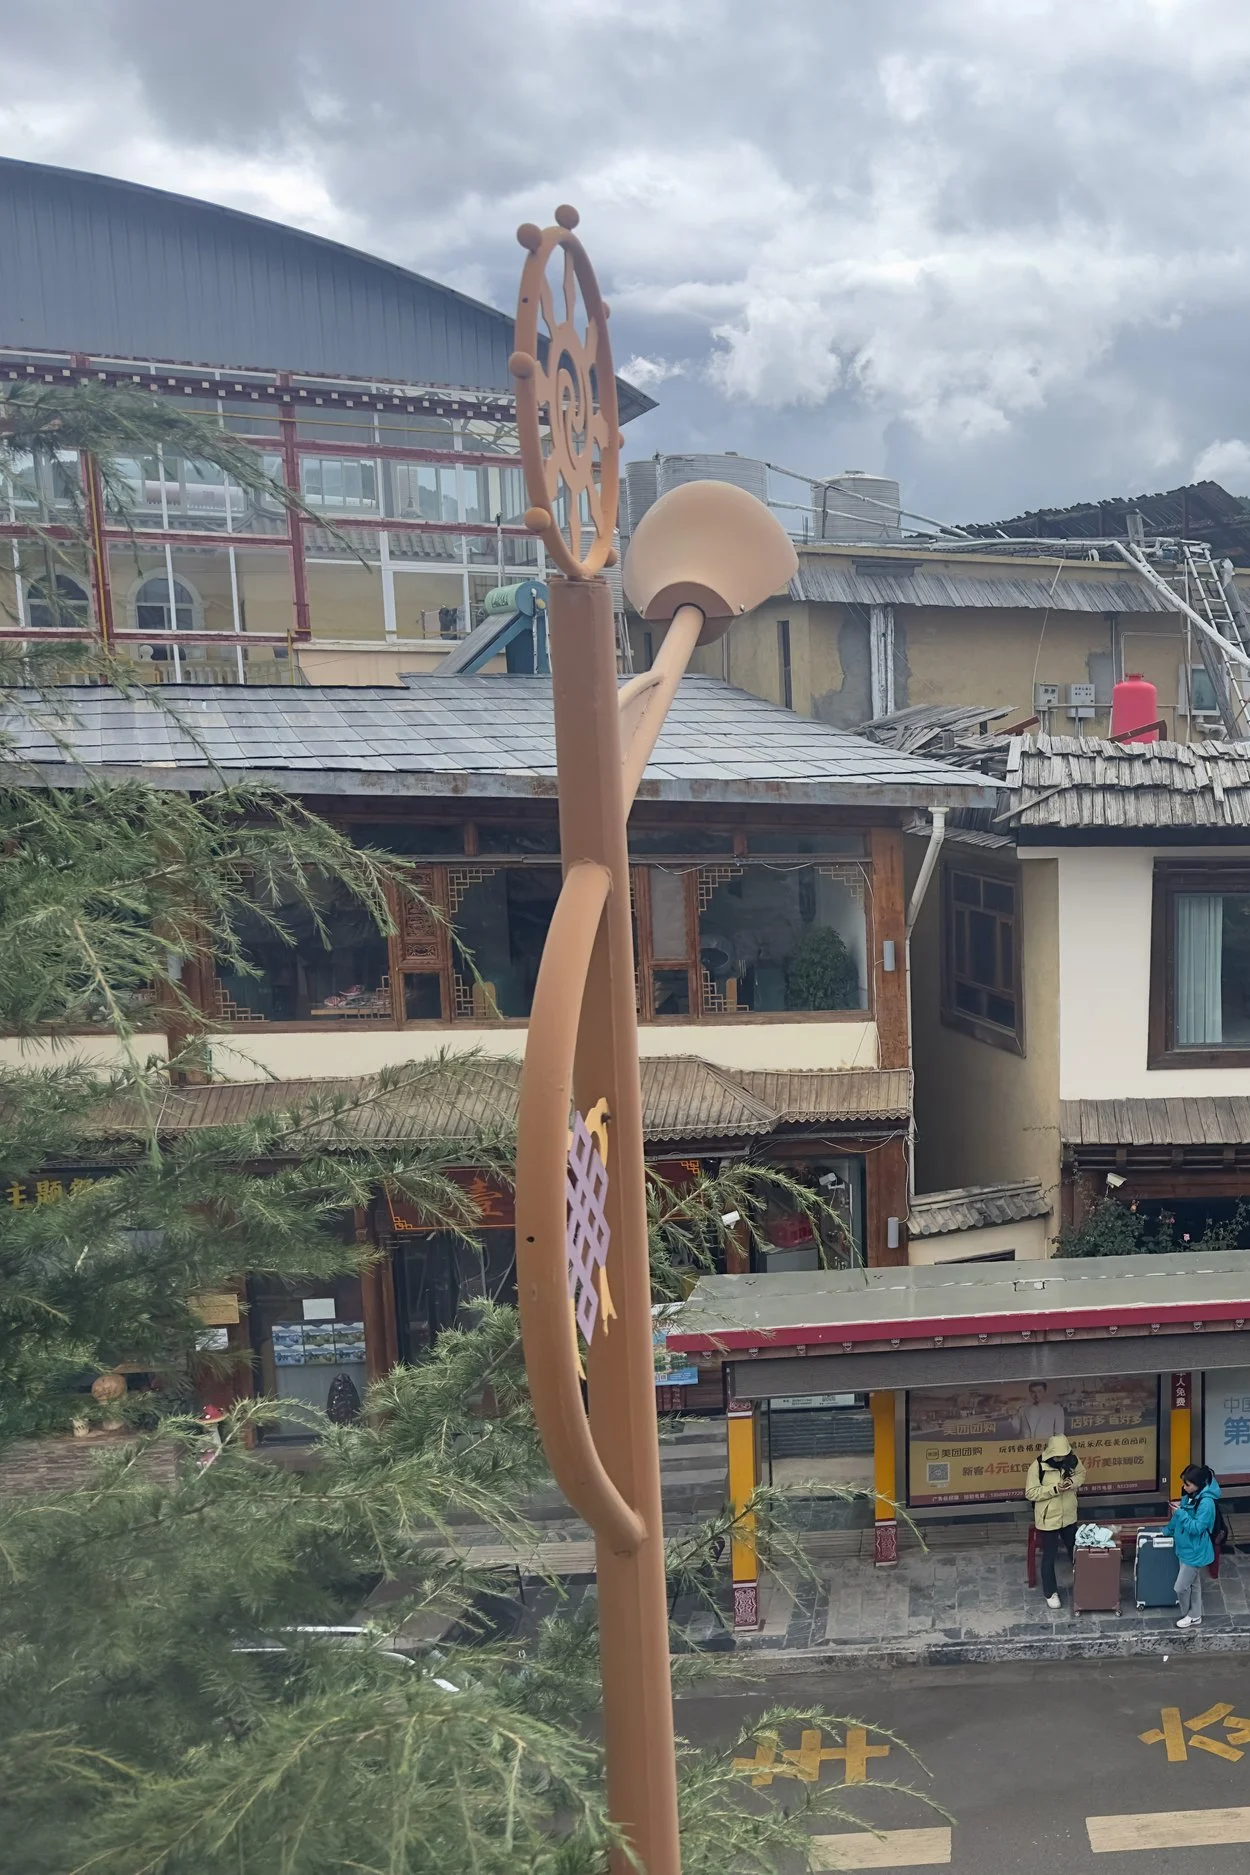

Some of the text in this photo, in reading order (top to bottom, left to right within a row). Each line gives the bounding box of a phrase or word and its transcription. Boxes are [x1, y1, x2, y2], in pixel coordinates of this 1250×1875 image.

[943, 1421, 996, 1436] 美团团购
[941, 1447, 983, 1458] 美团团购
